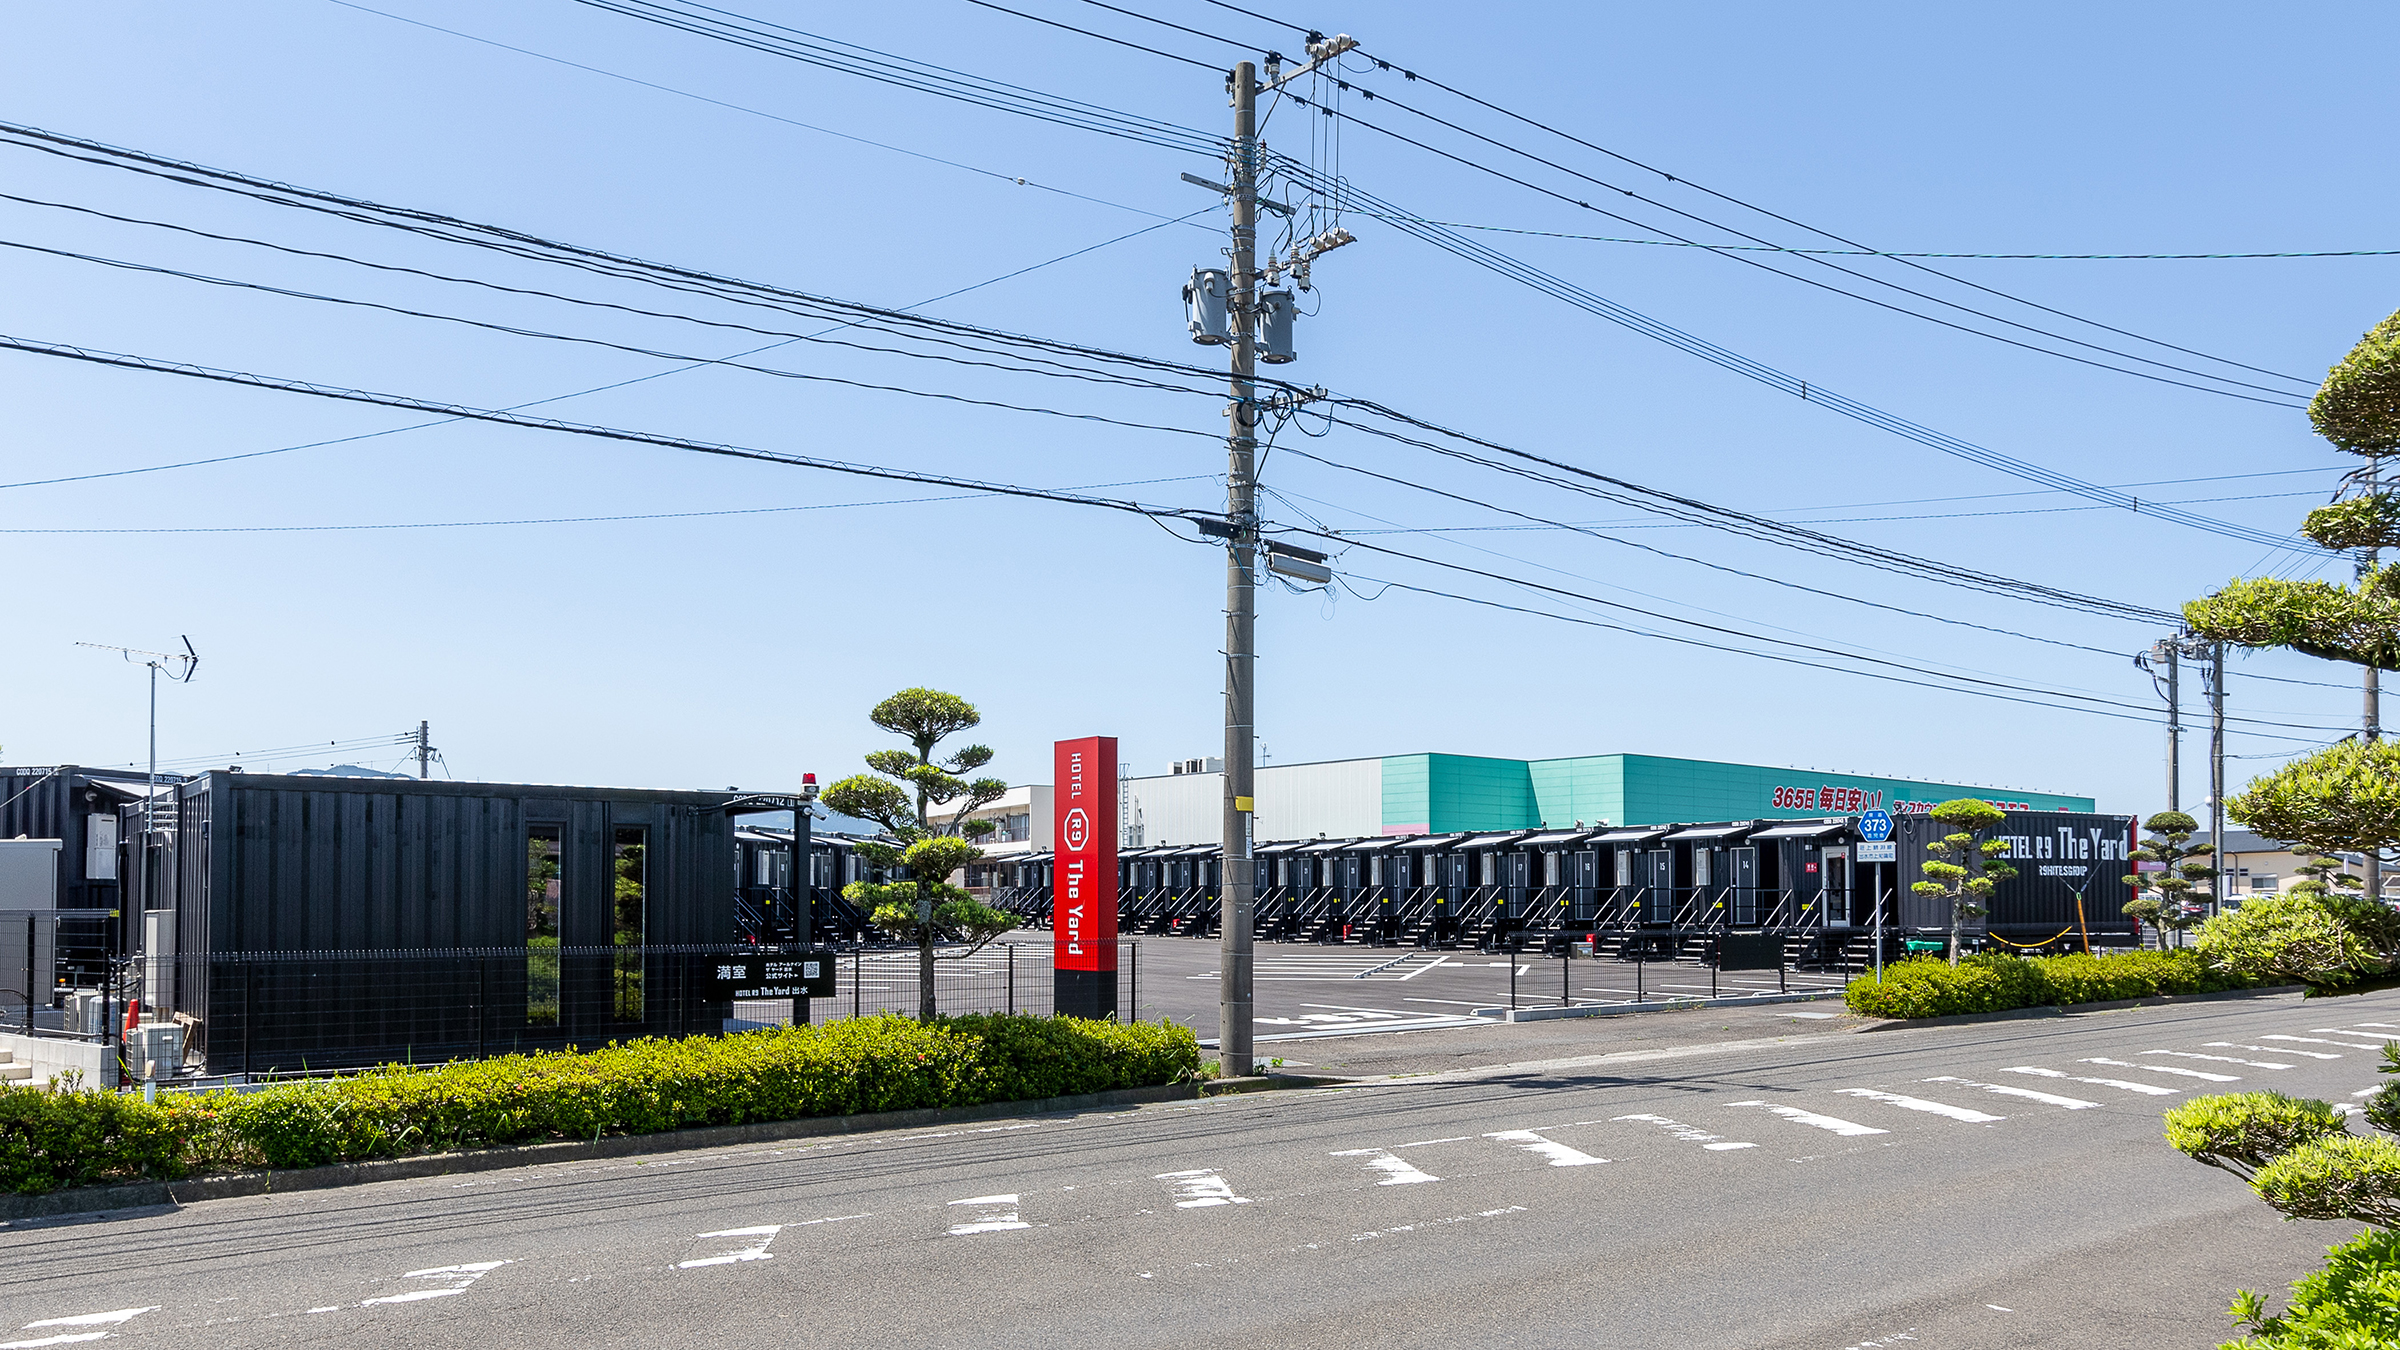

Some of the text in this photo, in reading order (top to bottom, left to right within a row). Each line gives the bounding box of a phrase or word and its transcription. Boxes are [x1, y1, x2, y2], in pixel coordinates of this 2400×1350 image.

[1772, 785, 1815, 810] 365日
[1864, 818, 1887, 832] 373
[2035, 836, 2052, 859] R9
[2058, 827, 2088, 860] The
[2089, 828, 2129, 861] Yard
[1068, 752, 1084, 955] HOTEL R9 The Yard
[1742, 861, 1749, 869] 14
[717, 965, 747, 980] 満室
[760, 986, 774, 996] The
[773, 985, 790, 995] Yard
[792, 985, 808, 995] 出水
